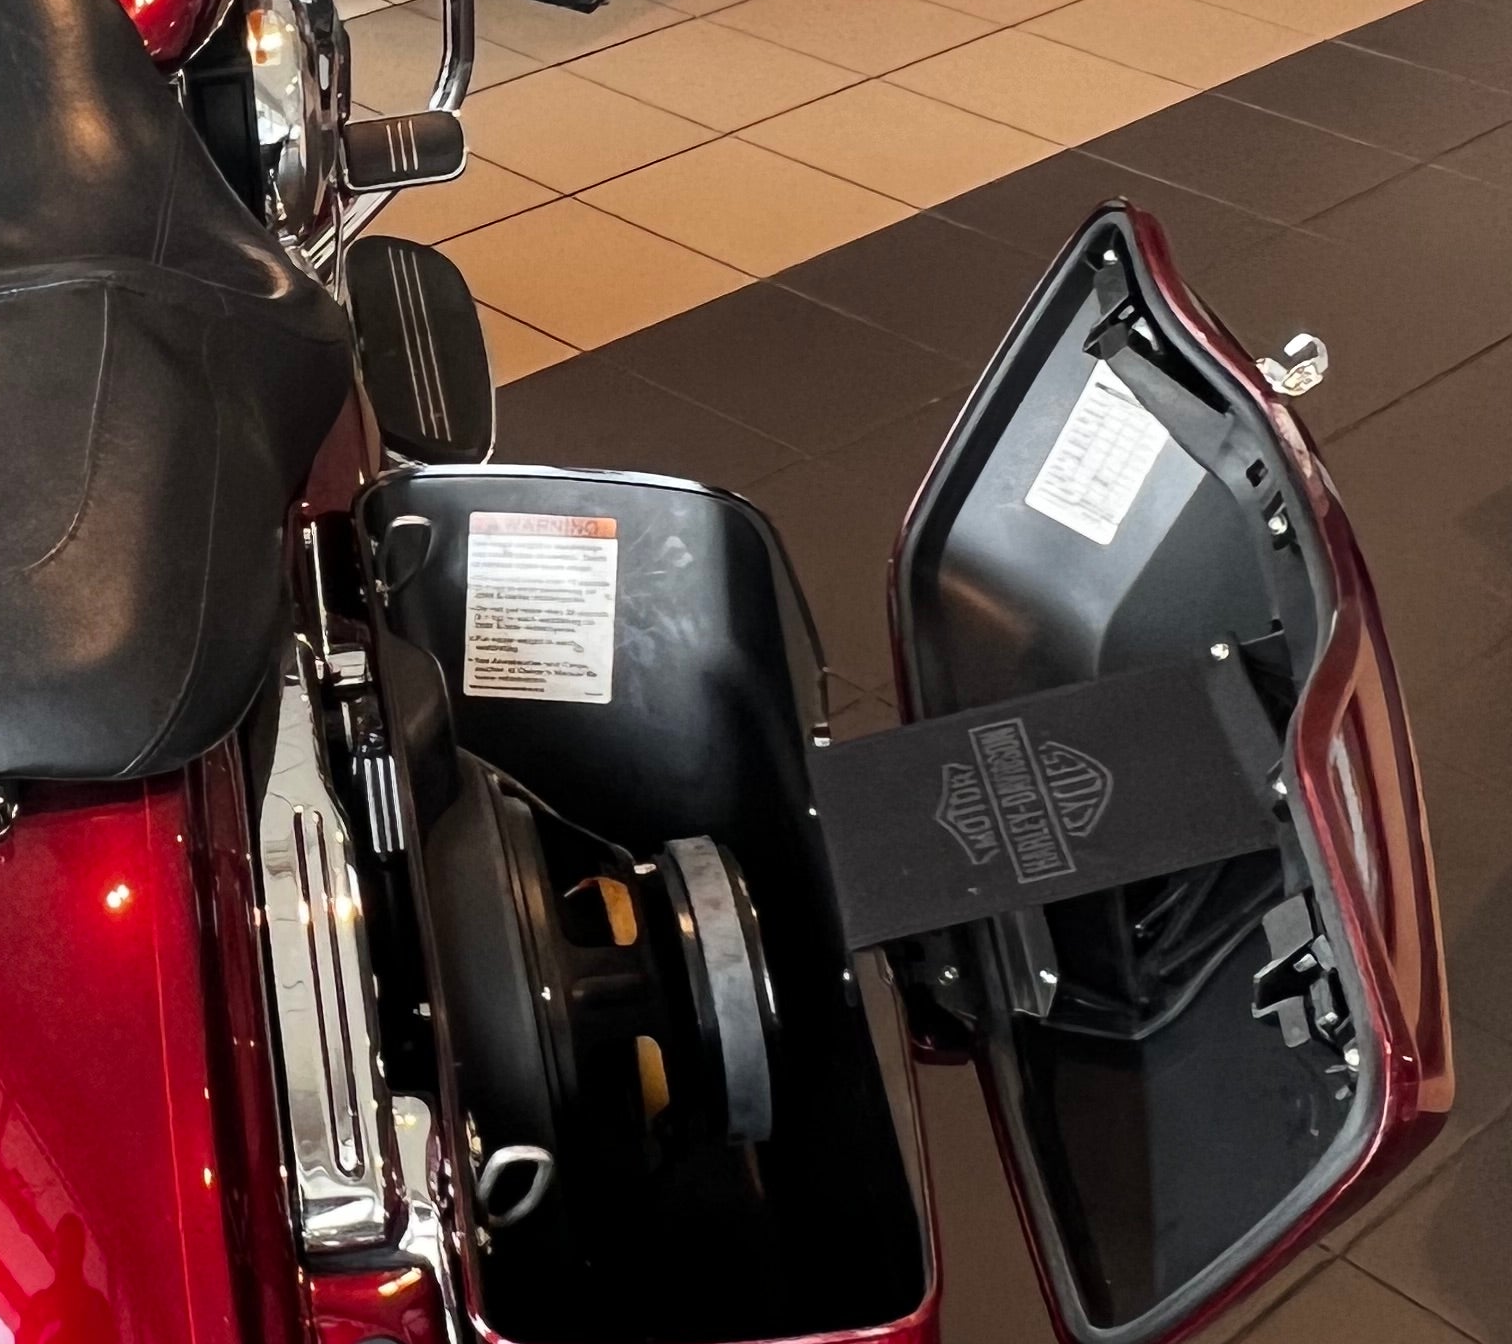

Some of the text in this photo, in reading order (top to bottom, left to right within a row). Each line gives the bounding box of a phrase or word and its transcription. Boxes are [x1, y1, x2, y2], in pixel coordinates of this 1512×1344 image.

[947, 771, 998, 850] MOTOR
[978, 726, 1061, 874] HARLEY-DAVIDSON
[1041, 750, 1103, 831] CYCLES
